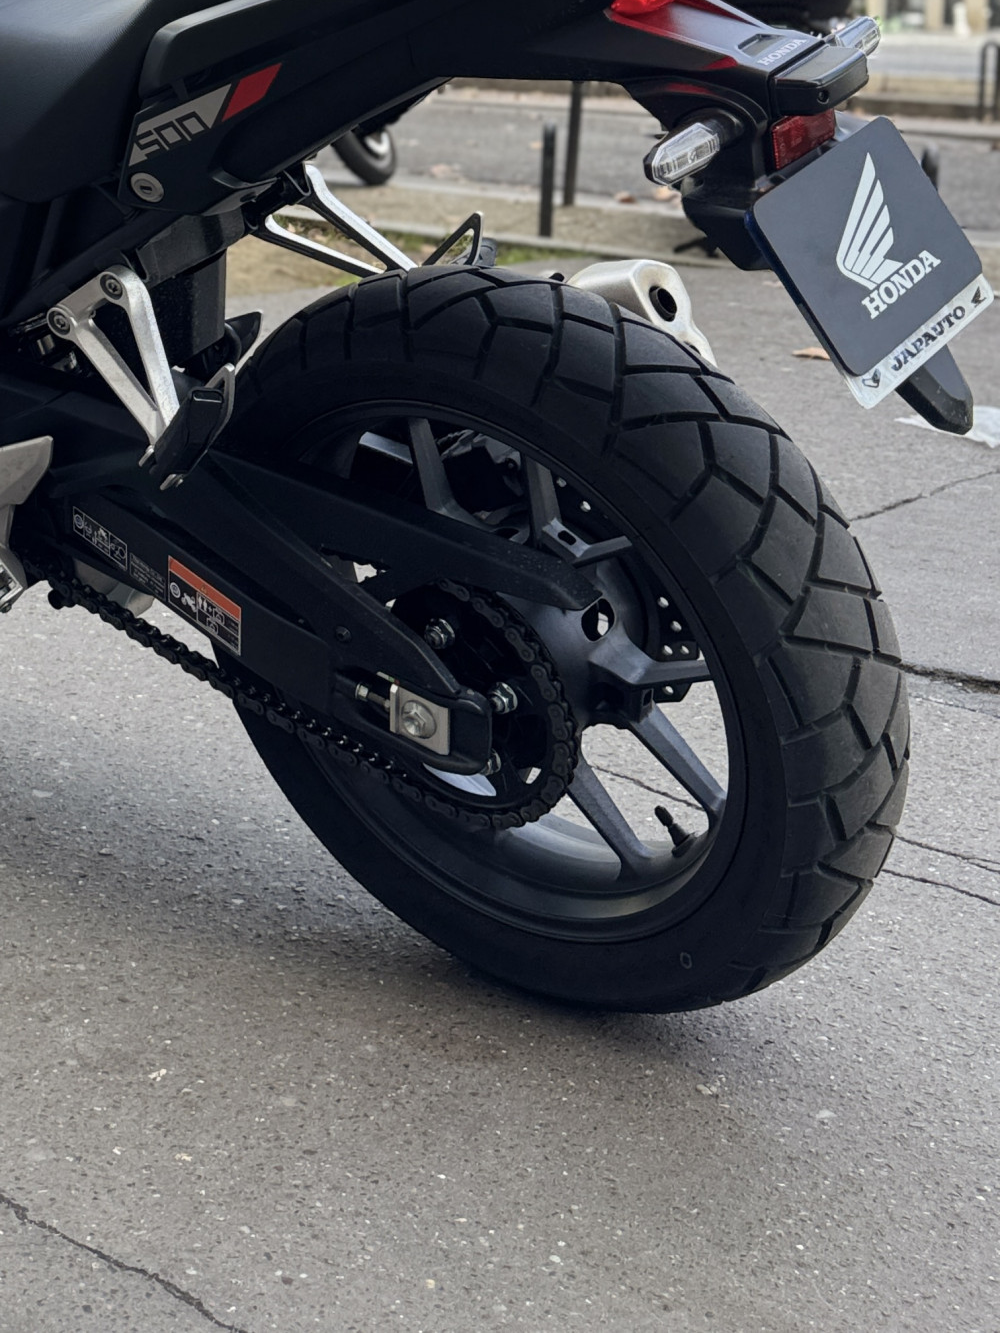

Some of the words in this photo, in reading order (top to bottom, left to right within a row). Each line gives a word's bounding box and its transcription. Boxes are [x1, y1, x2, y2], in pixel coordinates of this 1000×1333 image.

[757, 39, 808, 66] HONDA
[861, 249, 941, 319] HONDA
[890, 305, 966, 372] JAPAUTO
